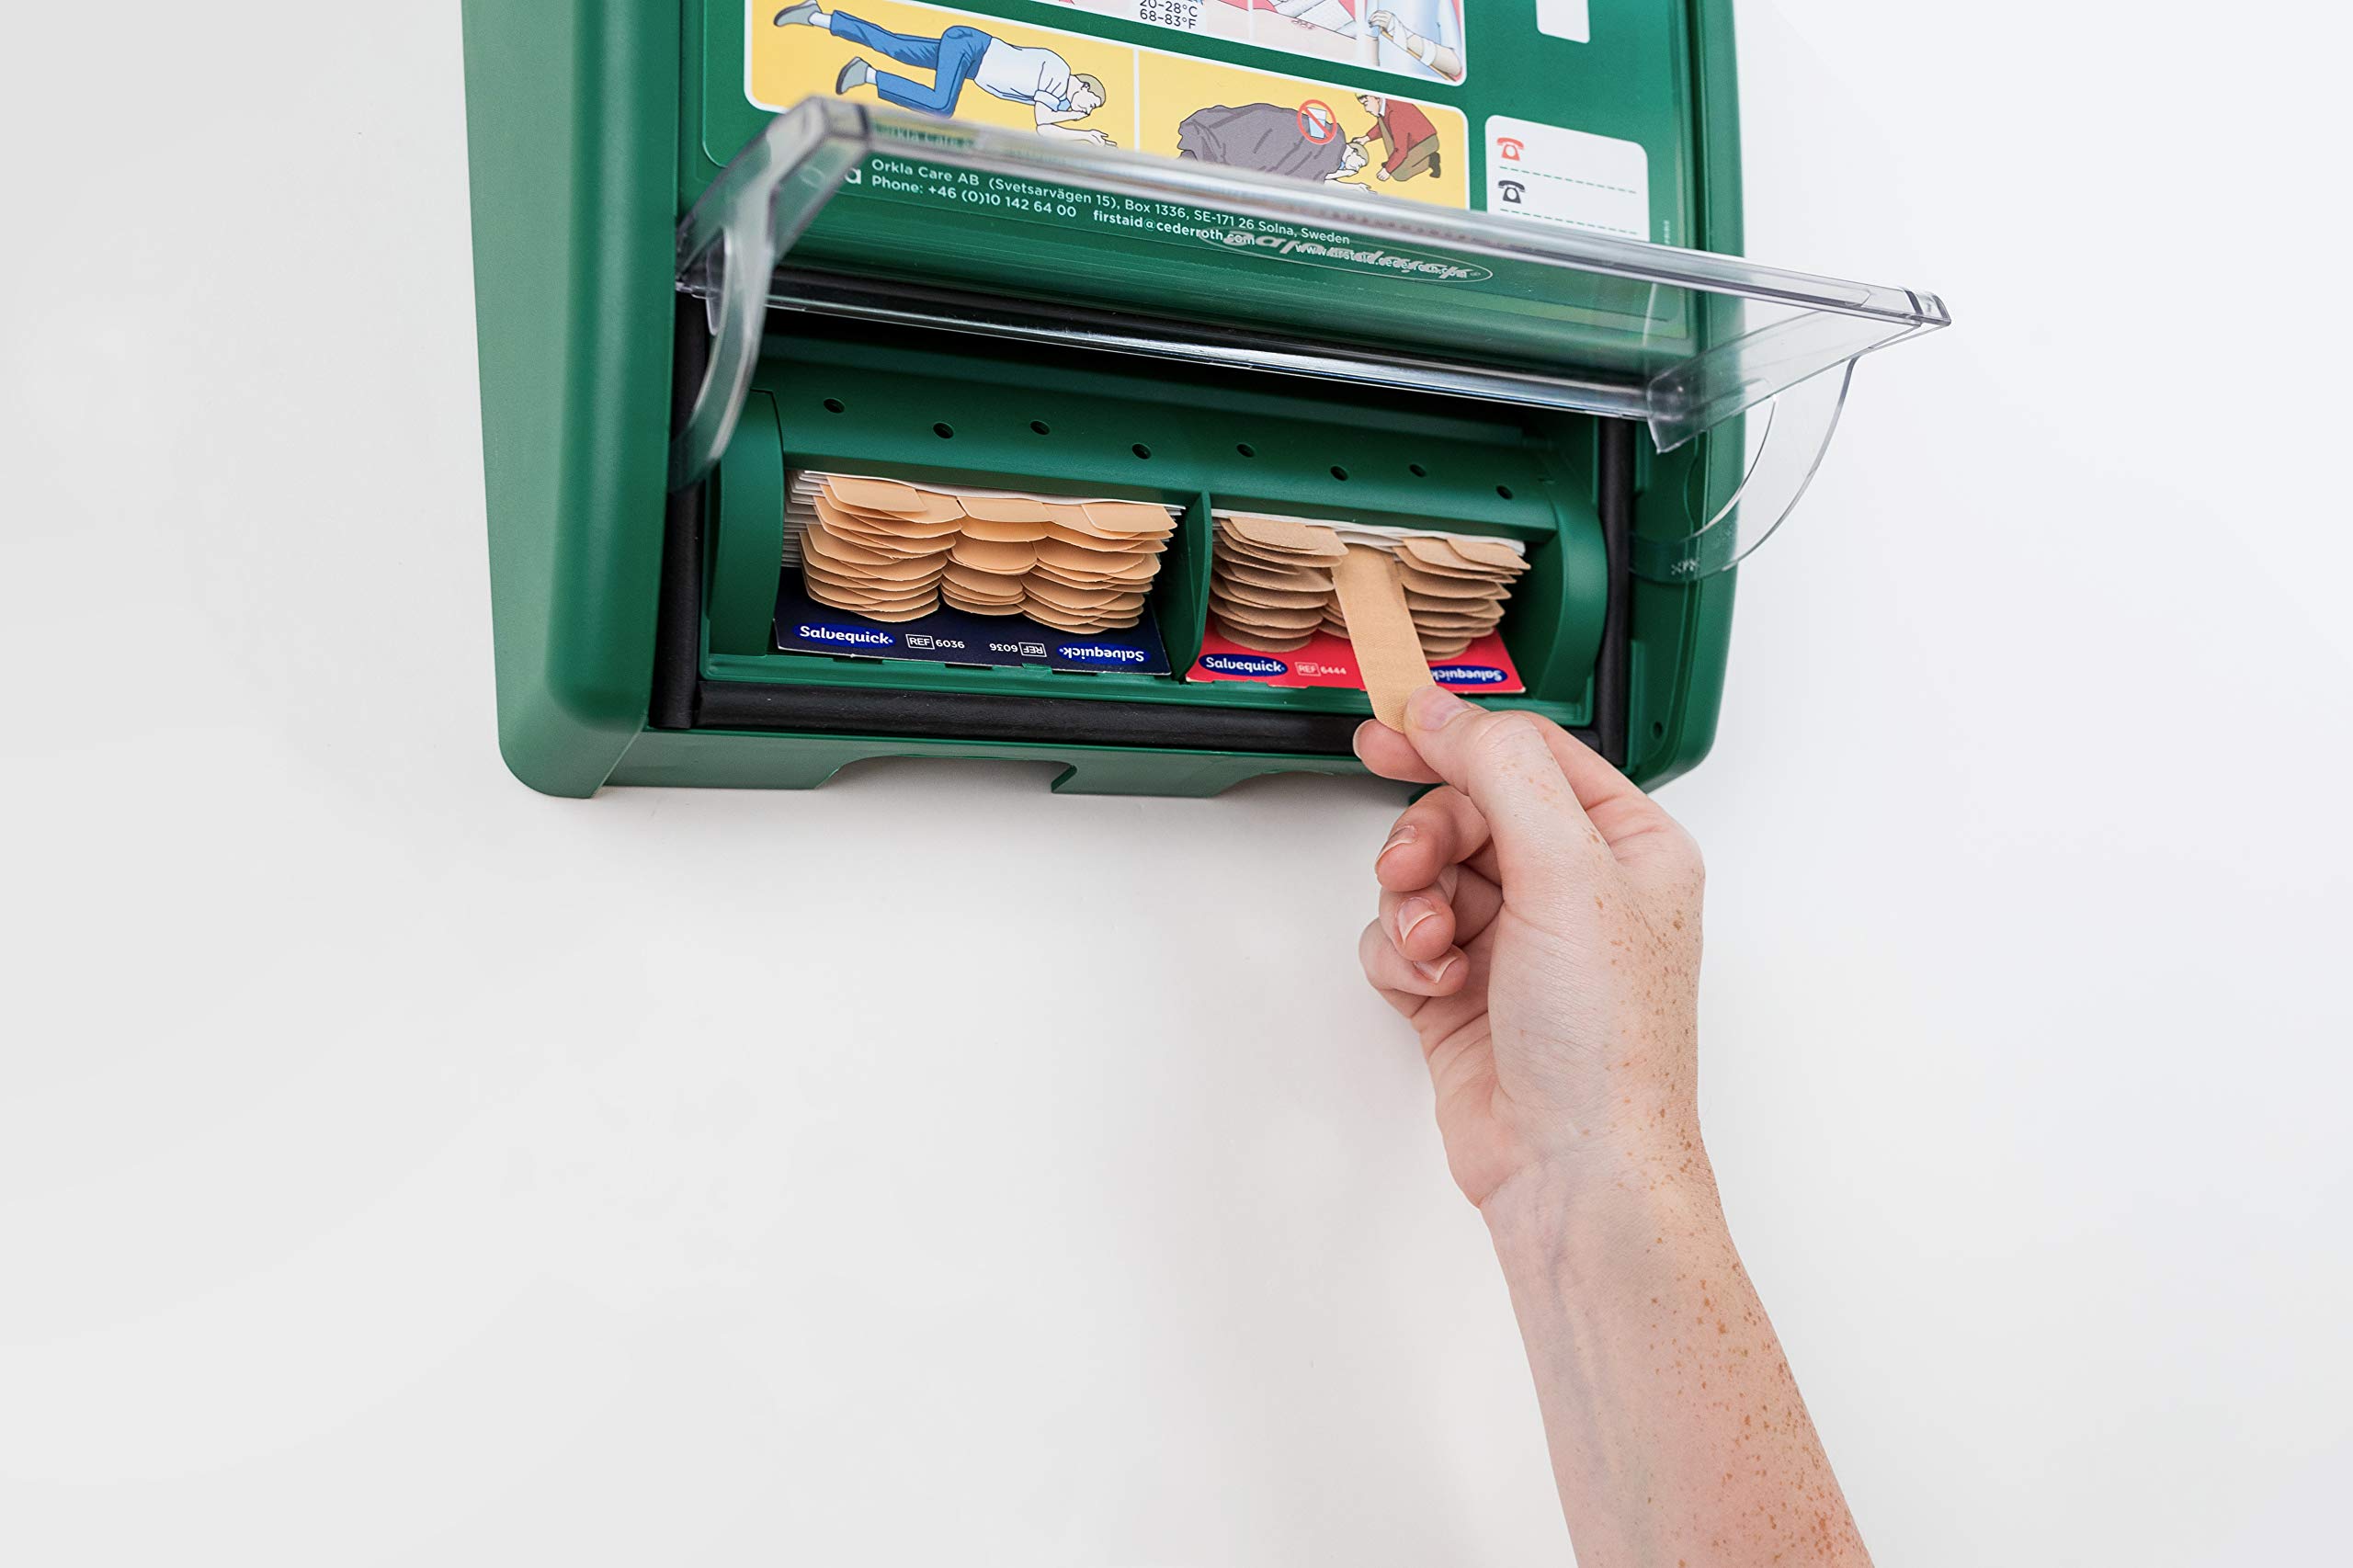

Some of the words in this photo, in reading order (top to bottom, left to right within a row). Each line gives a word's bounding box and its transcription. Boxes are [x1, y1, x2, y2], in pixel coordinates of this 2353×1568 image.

[1140, 8, 1197, 29] 68-83°F
[871, 175, 924, 195] Phone:
[928, 185, 957, 199] +46
[961, 188, 1001, 206] (0)10
[1006, 197, 1029, 211] 142
[1034, 202, 1051, 215] 64
[1057, 204, 1077, 218] 00
[871, 158, 914, 176] Orkla
[918, 165, 953, 183] Care
[958, 172, 980, 187] AB
[989, 176, 1092, 204] (Svetsarvägen
[1097, 194, 1120, 210] 15),
[1125, 199, 1151, 214] Box
[1155, 204, 1189, 221] 1336,
[1194, 210, 1235, 227] SE-171
[1238, 217, 1256, 231] 26
[1258, 221, 1298, 238] Solna,
[1301, 227, 1350, 245] Sweden
[799, 625, 889, 644] Salvequick
[908, 636, 931, 647] REF
[936, 639, 965, 649] 6036
[989, 642, 1018, 653] 6036
[1023, 645, 1044, 655] REF
[1063, 645, 1145, 663] Salvequick
[1205, 656, 1282, 673] Salvequick
[1298, 664, 1316, 675] REF
[1320, 665, 1347, 676] 6444
